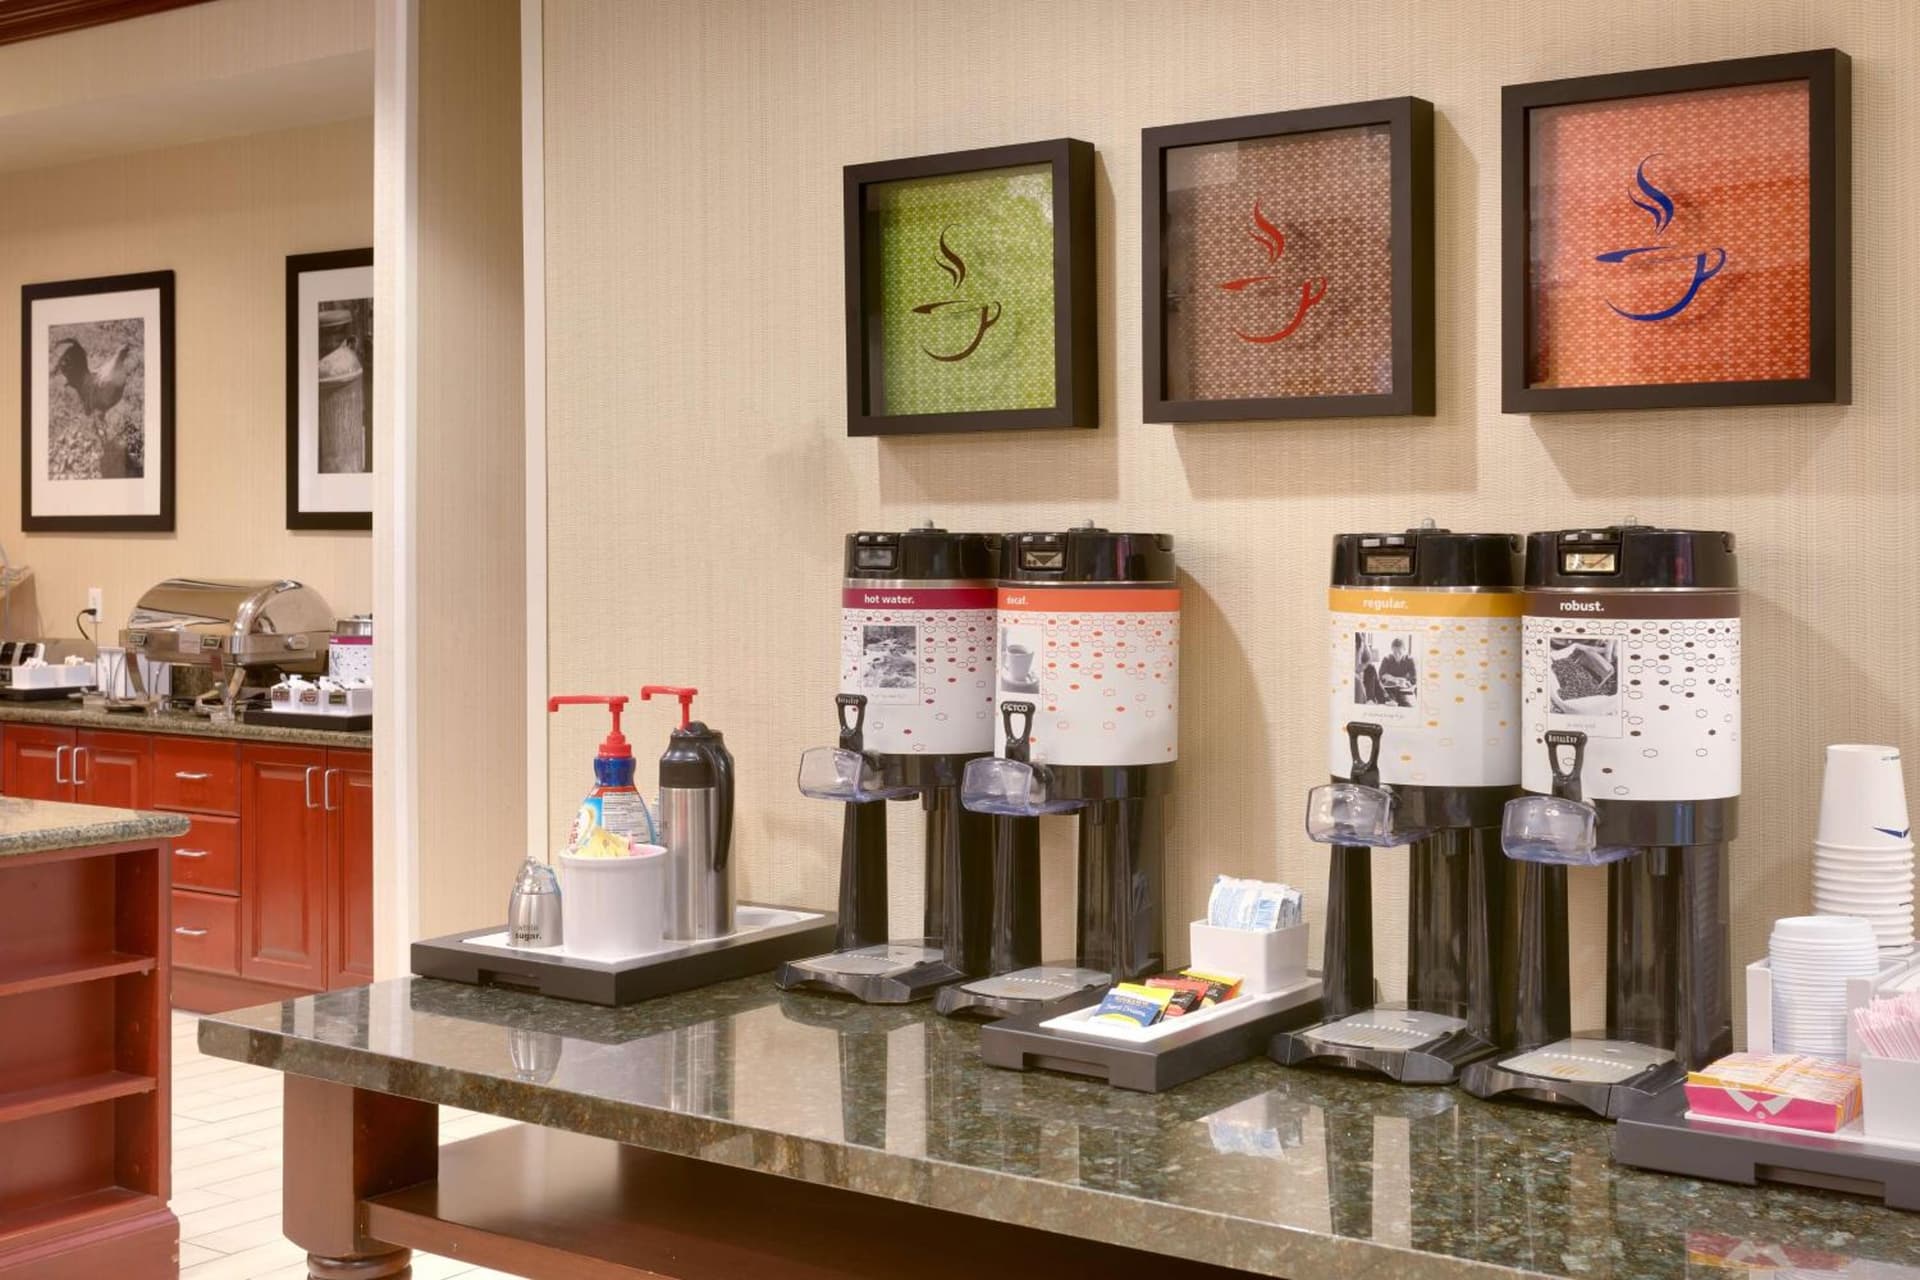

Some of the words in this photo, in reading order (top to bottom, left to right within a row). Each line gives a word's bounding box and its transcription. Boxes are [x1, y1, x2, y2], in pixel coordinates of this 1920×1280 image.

[864, 593, 880, 604] hot
[881, 594, 915, 605] water.
[1363, 598, 1408, 610] regular.
[1560, 600, 1605, 611] robust.
[515, 932, 542, 941] sugar.
